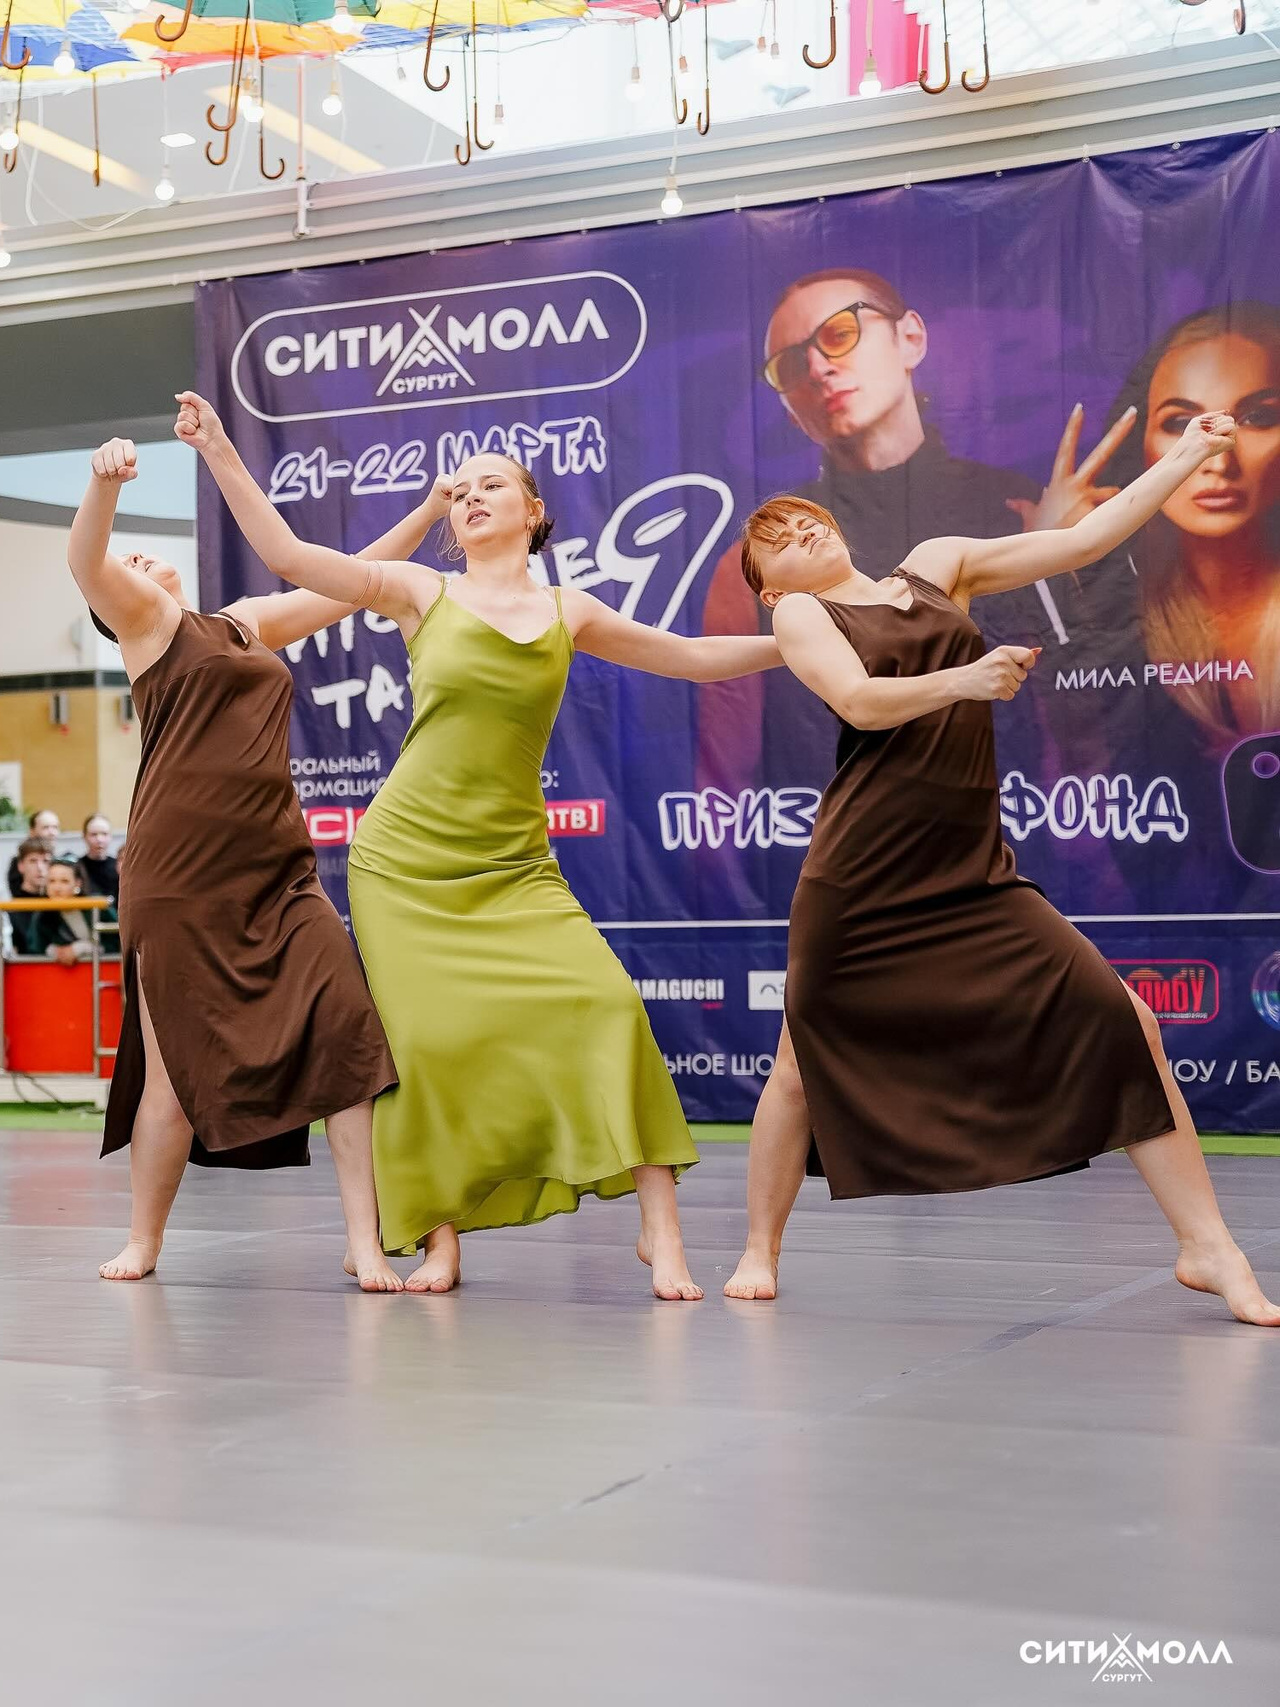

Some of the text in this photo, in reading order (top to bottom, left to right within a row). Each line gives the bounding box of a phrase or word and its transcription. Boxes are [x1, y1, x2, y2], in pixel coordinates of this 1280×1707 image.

[392, 371, 460, 395] СУРГУТ
[269, 439, 429, 504] 21-22
[311, 657, 414, 729] ТА
[1055, 659, 1254, 691] МИЛА РЕДИНА
[657, 770, 1189, 850] ПРИЗ ФОНД
[1167, 1058, 1217, 1083] ОУ
